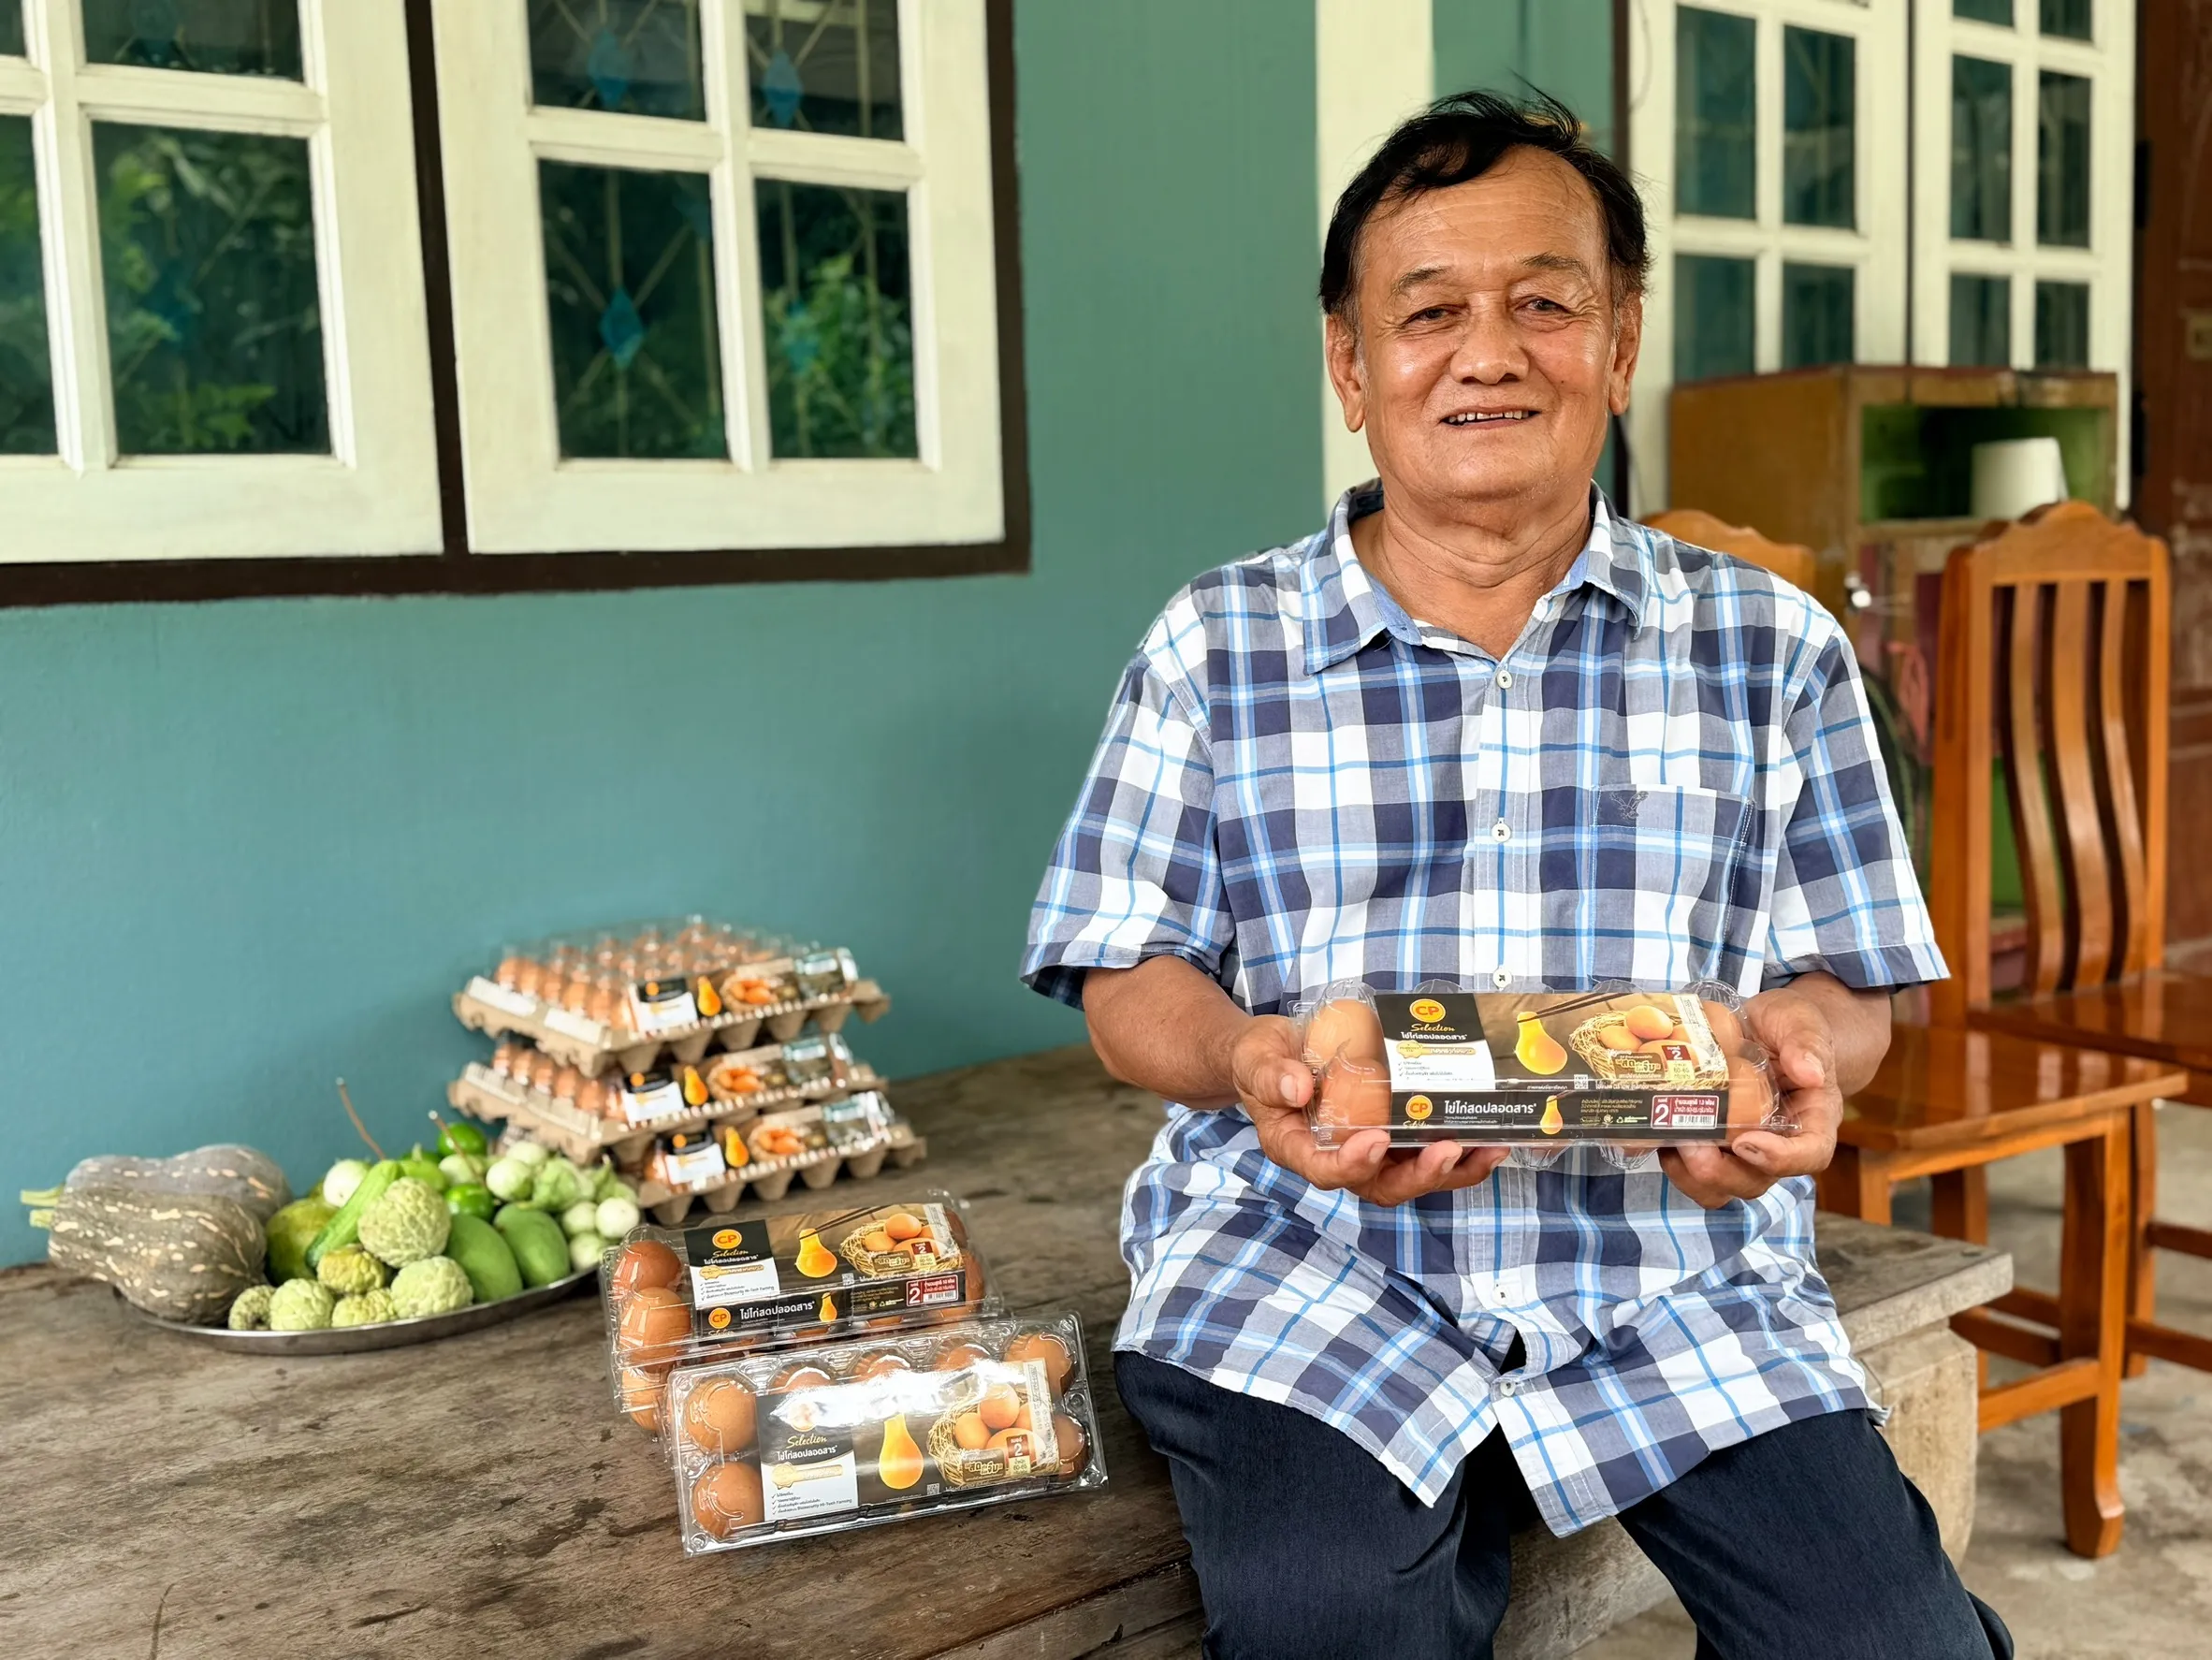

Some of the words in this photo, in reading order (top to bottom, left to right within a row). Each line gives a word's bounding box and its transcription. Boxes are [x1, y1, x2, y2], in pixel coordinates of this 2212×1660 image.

[1415, 1006, 1439, 1015] CP
[1411, 1024, 1455, 1032] Selection
[1672, 1050, 1682, 1060] 2
[1409, 1102, 1428, 1113] CP
[1653, 1103, 1669, 1125] 2
[717, 1235, 737, 1244] CP
[712, 1248, 749, 1259] Selection
[909, 1287, 921, 1304] 2
[712, 1314, 727, 1322] CP
[786, 1434, 828, 1449] Selection
[1013, 1443, 1024, 1456] 2
